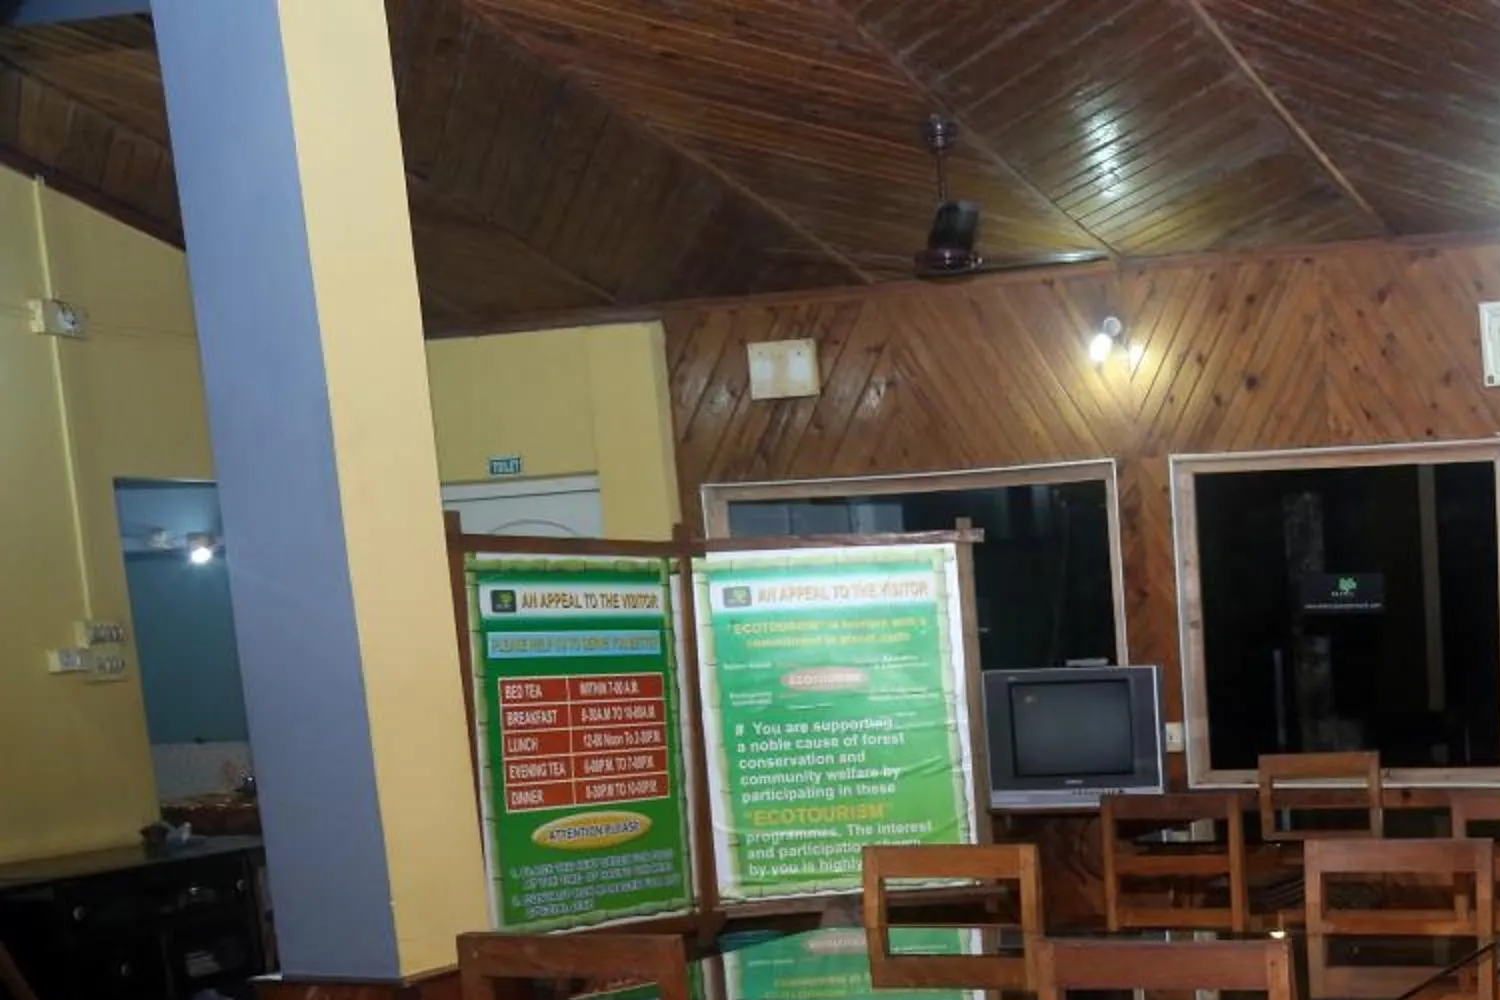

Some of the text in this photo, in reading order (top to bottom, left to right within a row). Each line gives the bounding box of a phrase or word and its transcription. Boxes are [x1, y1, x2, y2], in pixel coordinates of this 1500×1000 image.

[539, 592, 582, 609] APPEAL
[584, 592, 598, 609] TO
[600, 592, 620, 609] THE
[779, 586, 830, 602] APPEAL
[832, 585, 849, 600] TO
[505, 684, 543, 699] BED TEA
[506, 709, 558, 726] BREAKFAST
[752, 721, 781, 736] You
[785, 723, 808, 734] are
[813, 715, 893, 735] supporting
[507, 737, 539, 753] LUNCH
[737, 731, 905, 753] a noble cause of forest
[738, 750, 866, 770] conservation and
[509, 761, 567, 779] EVENING TEA
[740, 765, 900, 787] community welfare by
[511, 789, 545, 805] DINNER
[742, 782, 896, 804] participating in these
[846, 822, 873, 837] The
[877, 819, 932, 835] interest
[747, 846, 775, 860] and
[779, 842, 862, 859] participatio
[749, 863, 766, 878] by
[772, 862, 799, 876] you
[803, 861, 815, 873] is
